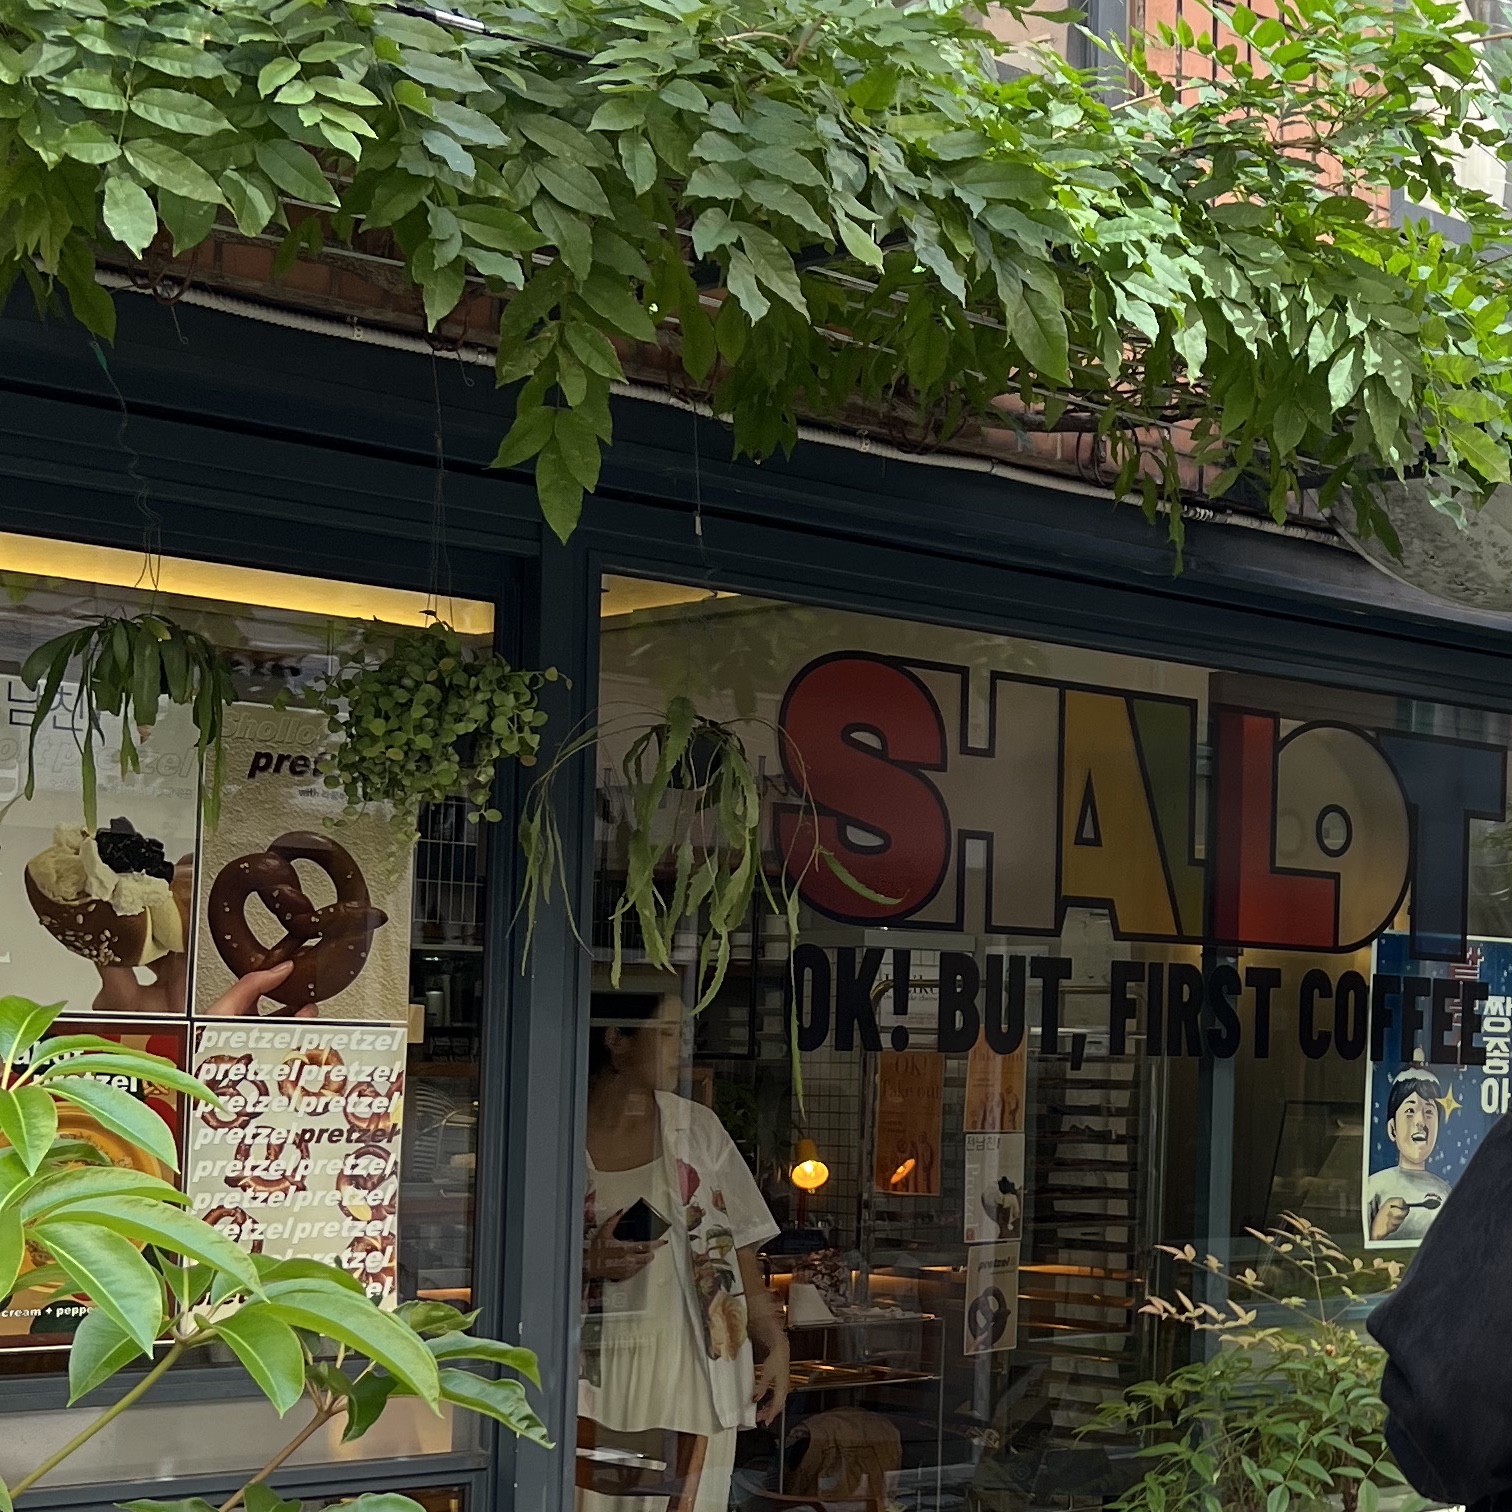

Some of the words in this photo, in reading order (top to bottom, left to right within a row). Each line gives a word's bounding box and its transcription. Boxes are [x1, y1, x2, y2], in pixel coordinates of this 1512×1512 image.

[790, 943, 911, 1053] OK!
[938, 951, 1084, 1071] BUT,
[1108, 961, 1281, 1059] FIRST
[1299, 967, 1489, 1065] COFFEE
[1, 1306, 42, 1318] cream
